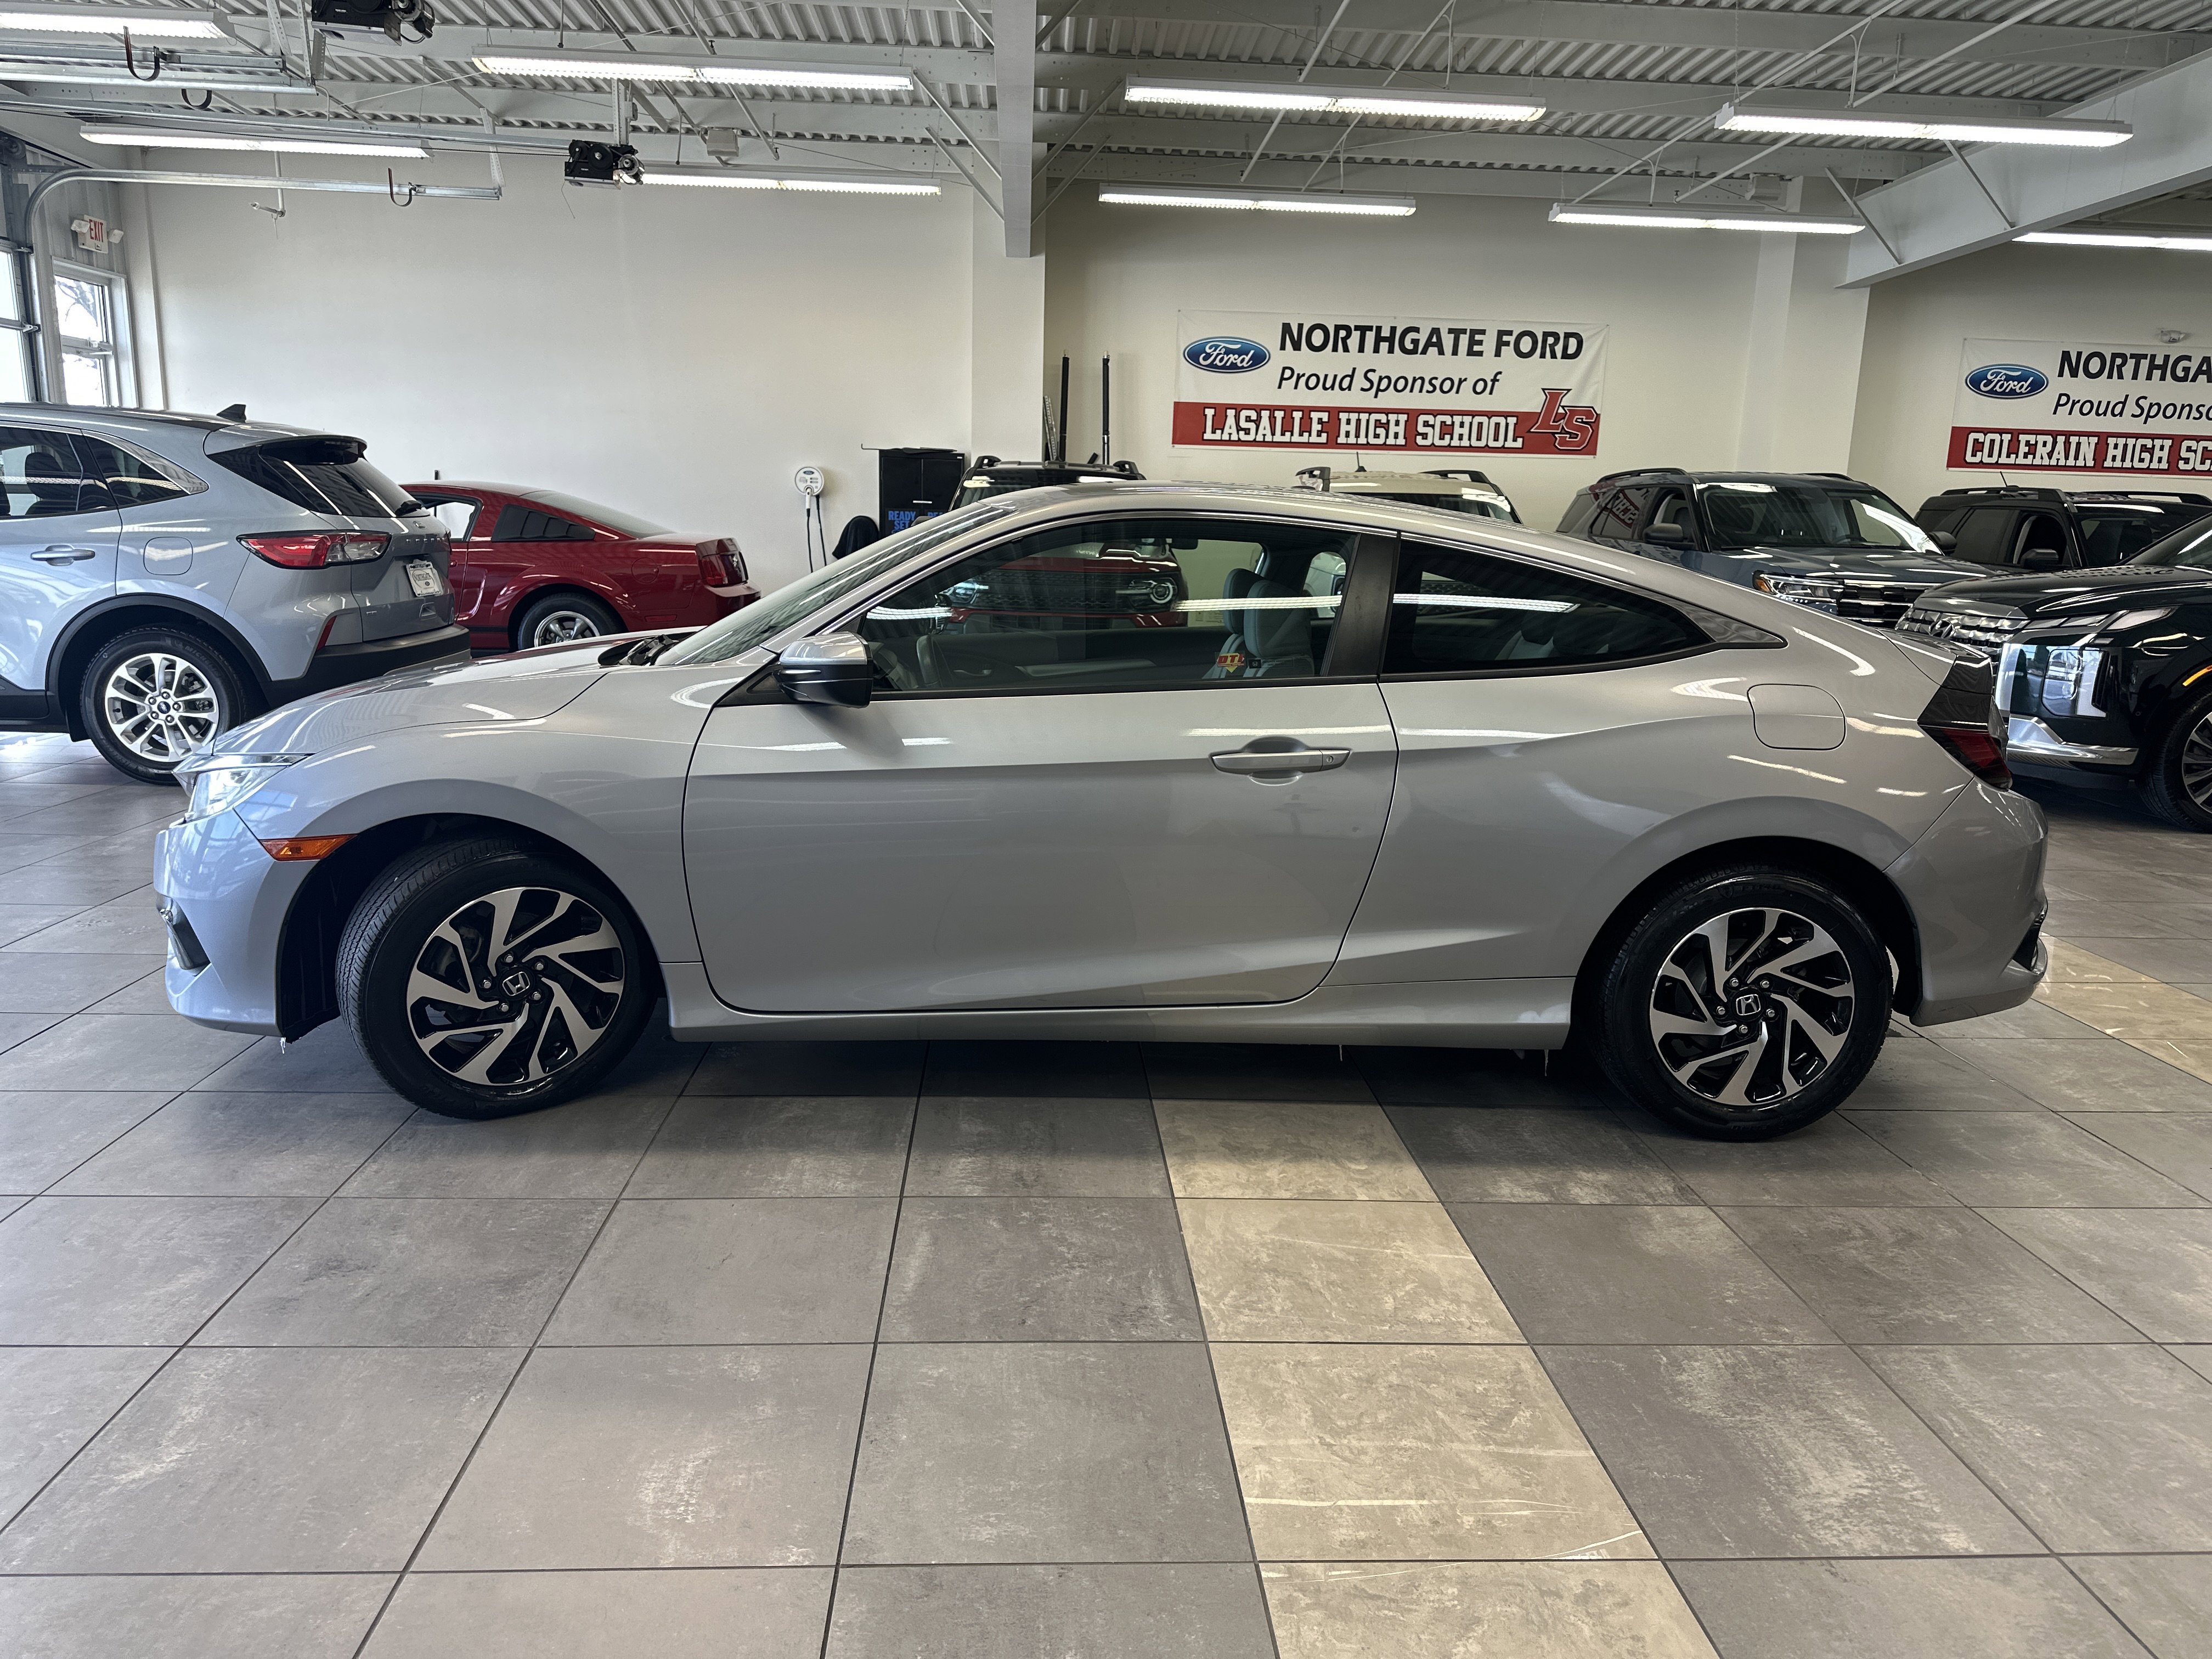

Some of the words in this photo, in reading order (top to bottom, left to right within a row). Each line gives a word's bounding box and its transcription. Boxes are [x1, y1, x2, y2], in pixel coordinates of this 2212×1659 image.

[89, 219, 104, 242] EXIT
[1199, 342, 1255, 368] Ford
[1279, 322, 1487, 357] NORTHGATE
[1494, 330, 1584, 360] FORD
[1980, 369, 2034, 393] Ford
[2057, 350, 2212, 383] NORTHGA
[1277, 366, 1357, 392] Proud
[1360, 368, 1468, 399] Sponsor
[1472, 371, 1503, 396] of
[1526, 388, 1599, 452] LS
[2052, 393, 2130, 418] Proud
[1203, 408, 1328, 444] LASALLE
[1337, 411, 1408, 445] HIGH
[1416, 414, 1523, 449] SCHOOL
[1965, 432, 2098, 467] COLERAIN
[2103, 437, 2172, 470] HIGH
[888, 510, 916, 521] READY
[894, 520, 910, 530] SET
